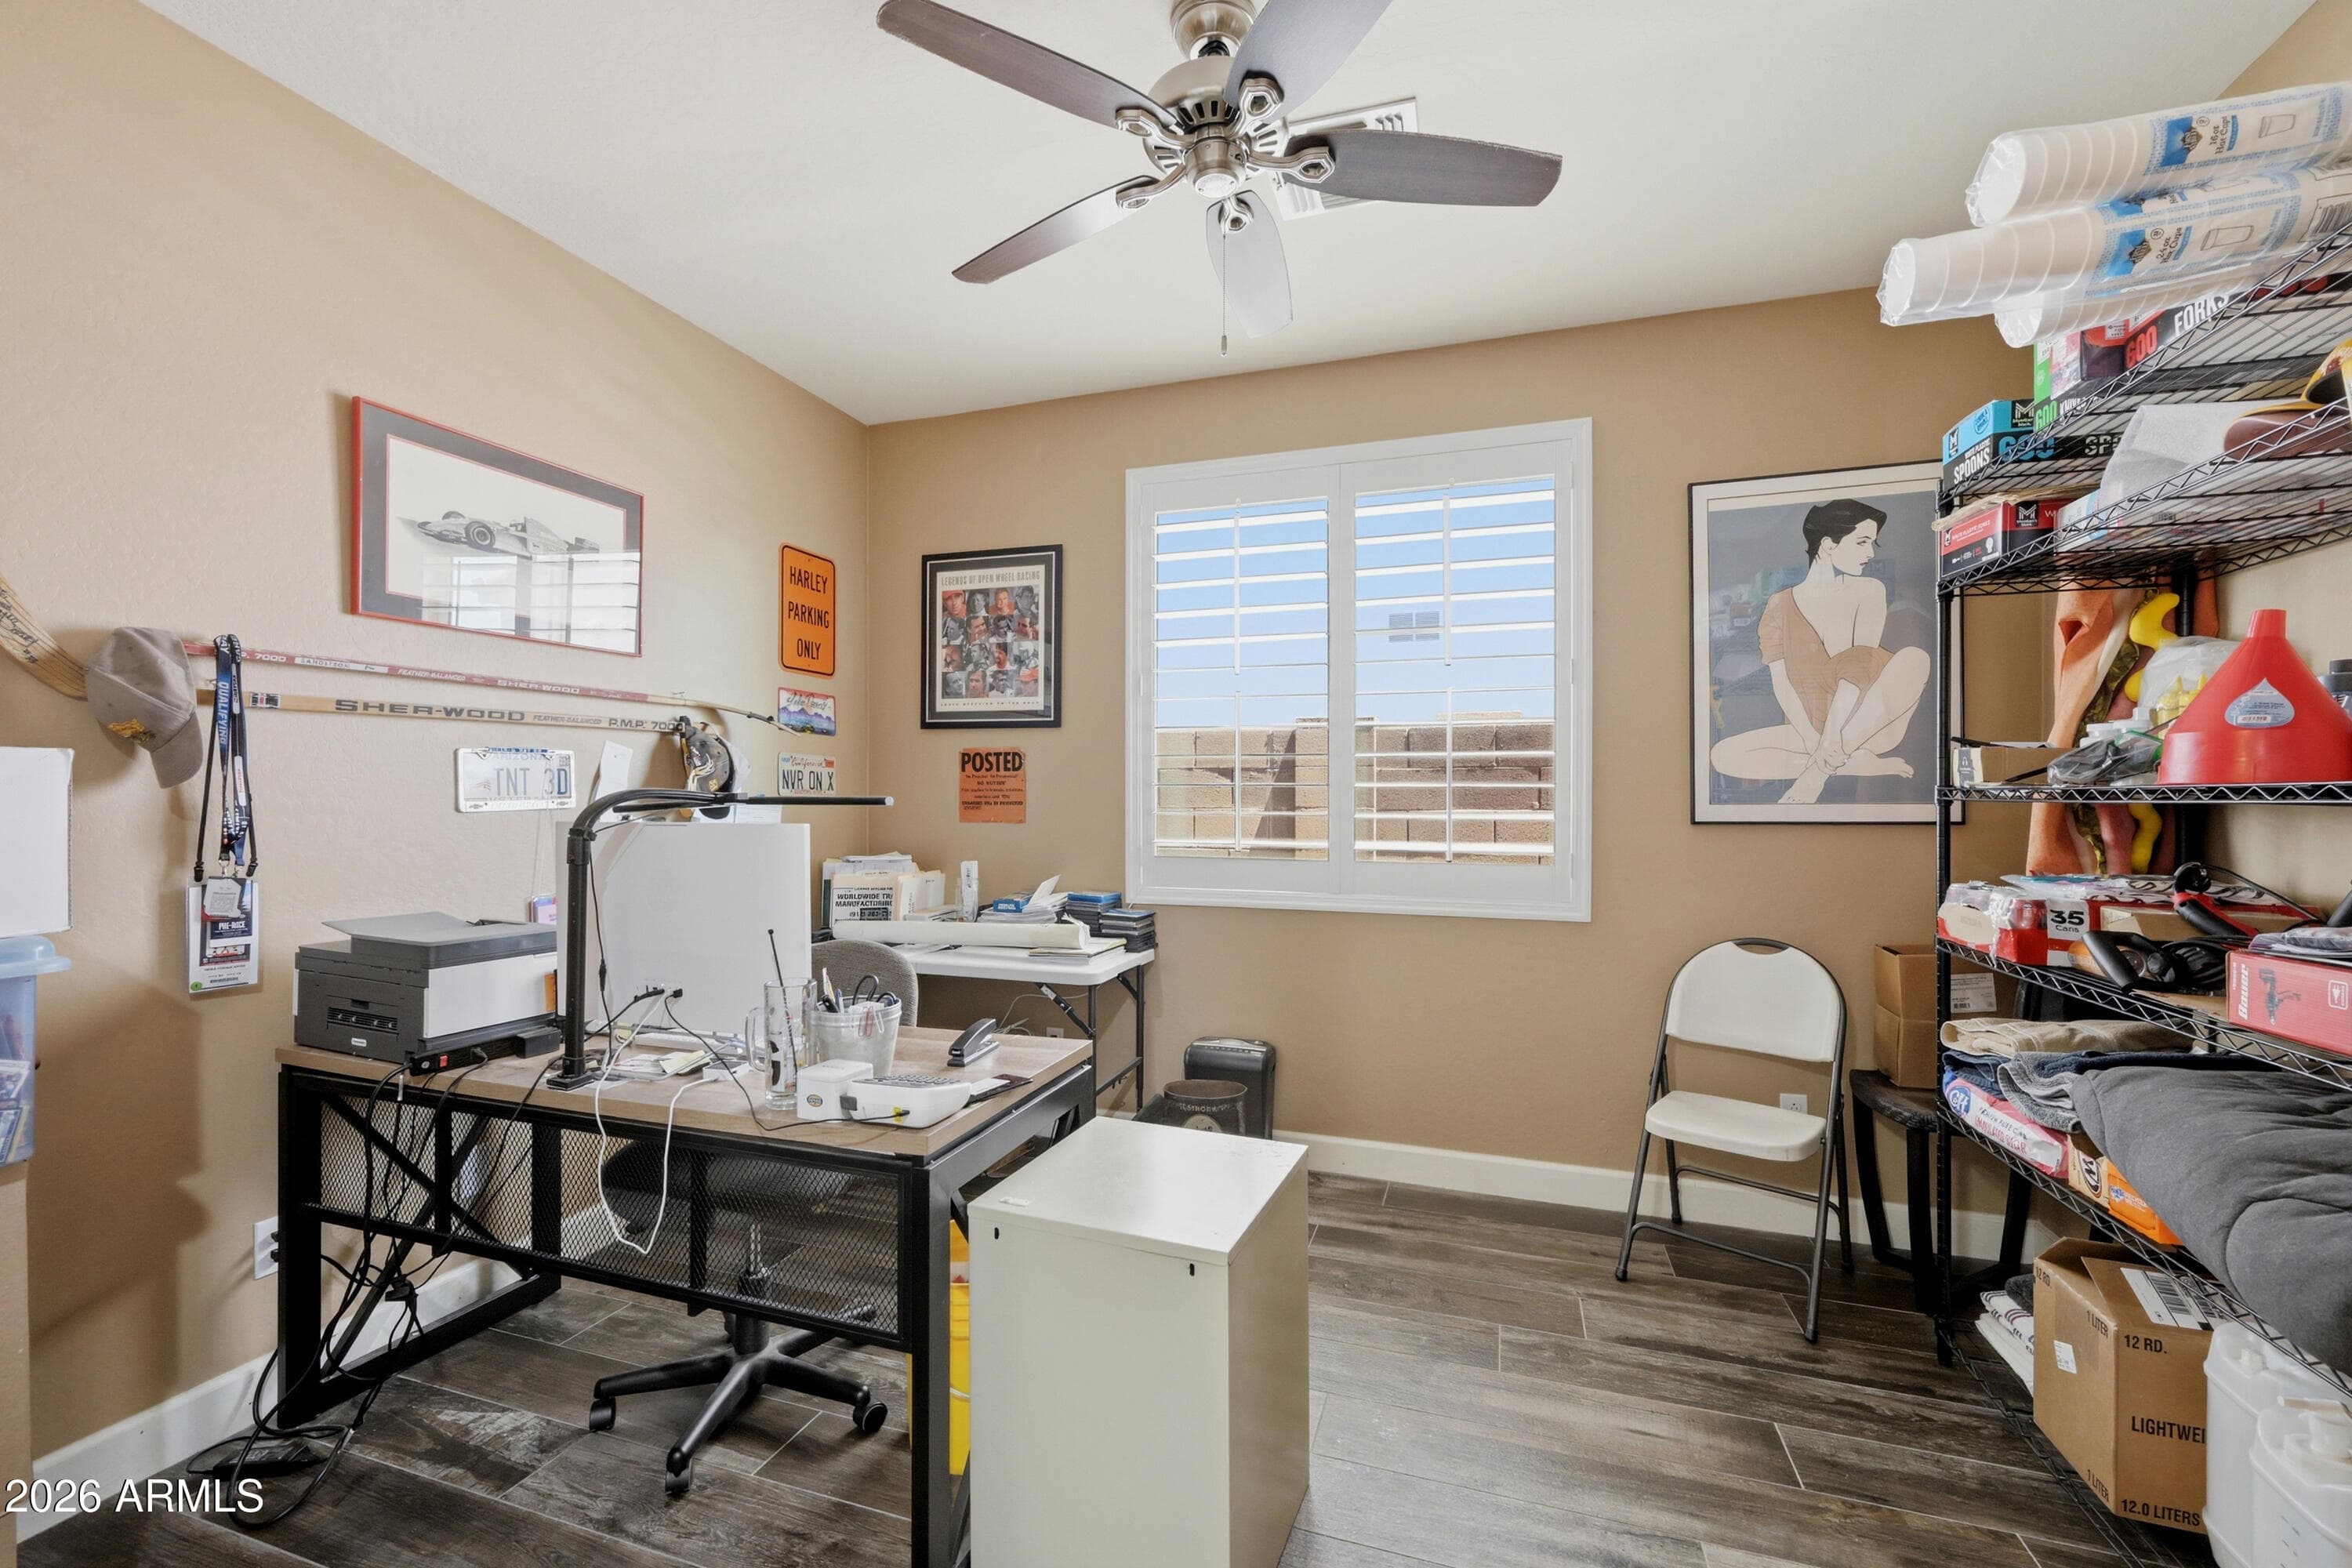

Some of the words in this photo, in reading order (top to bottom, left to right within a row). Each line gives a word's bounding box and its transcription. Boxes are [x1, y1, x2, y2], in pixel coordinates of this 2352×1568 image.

[1954, 447, 1990, 485] SPOONS
[789, 565, 828, 593] HARLEY
[788, 601, 829, 629] PARKING
[255, 652, 287, 662] 7000
[797, 638, 821, 660] ONLY
[496, 679, 580, 694] SHER-WOOD
[217, 681, 230, 745] QUALIFYING
[336, 699, 525, 721] SHER-WOOD
[961, 752, 1023, 772] POSTED
[494, 768, 530, 796] TNT
[782, 769, 804, 789] NVR
[809, 771, 822, 791] ON
[828, 771, 834, 791] X
[219, 920, 245, 931] PRE-RACE
[2050, 909, 2084, 926] 35
[2036, 1266, 2042, 1280] 12
[2092, 1313, 2108, 1338] LITER
[2124, 1334, 2140, 1349] 12
[2143, 1336, 2168, 1354] RD.
[2094, 1472, 2110, 1502] LITER
[2122, 1498, 2150, 1517] 12.0
[2154, 1504, 2200, 1527] LITERS
